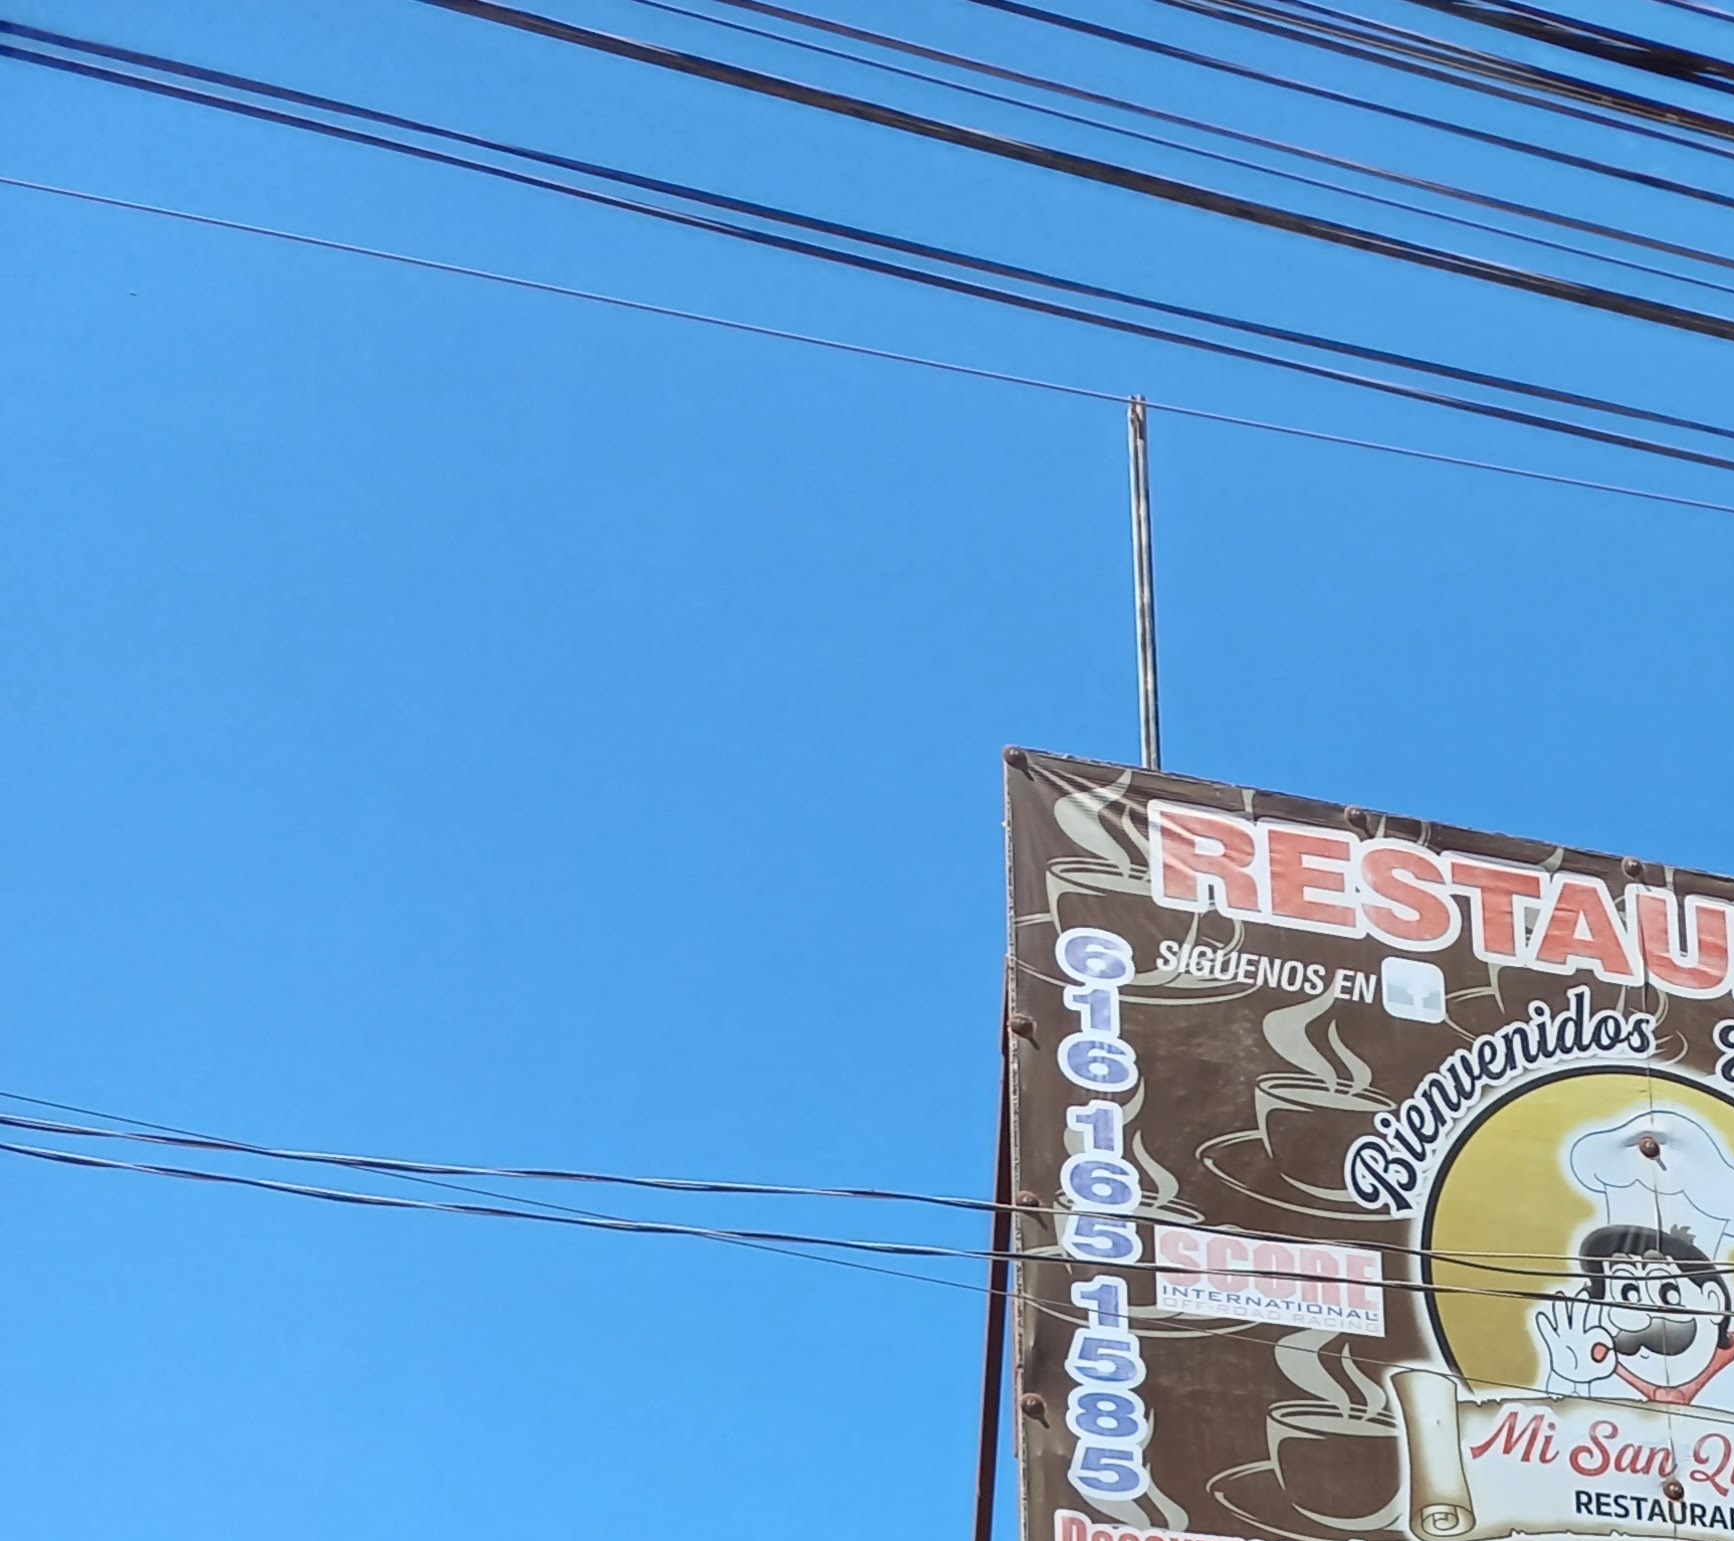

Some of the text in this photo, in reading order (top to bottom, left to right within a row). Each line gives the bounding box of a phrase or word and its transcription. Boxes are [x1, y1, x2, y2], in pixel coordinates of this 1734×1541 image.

[1156, 939, 1378, 1004] SIGUENOS EN
[1350, 989, 1651, 1212] Bienvenidos
[1063, 934, 1141, 1493] 616 165 1585
[1159, 1230, 1378, 1311] SCORE
[1162, 1297, 1379, 1334] OFF-ROAD RACING
[1469, 1410, 1560, 1464] Mi
[1569, 1420, 1678, 1478] San
